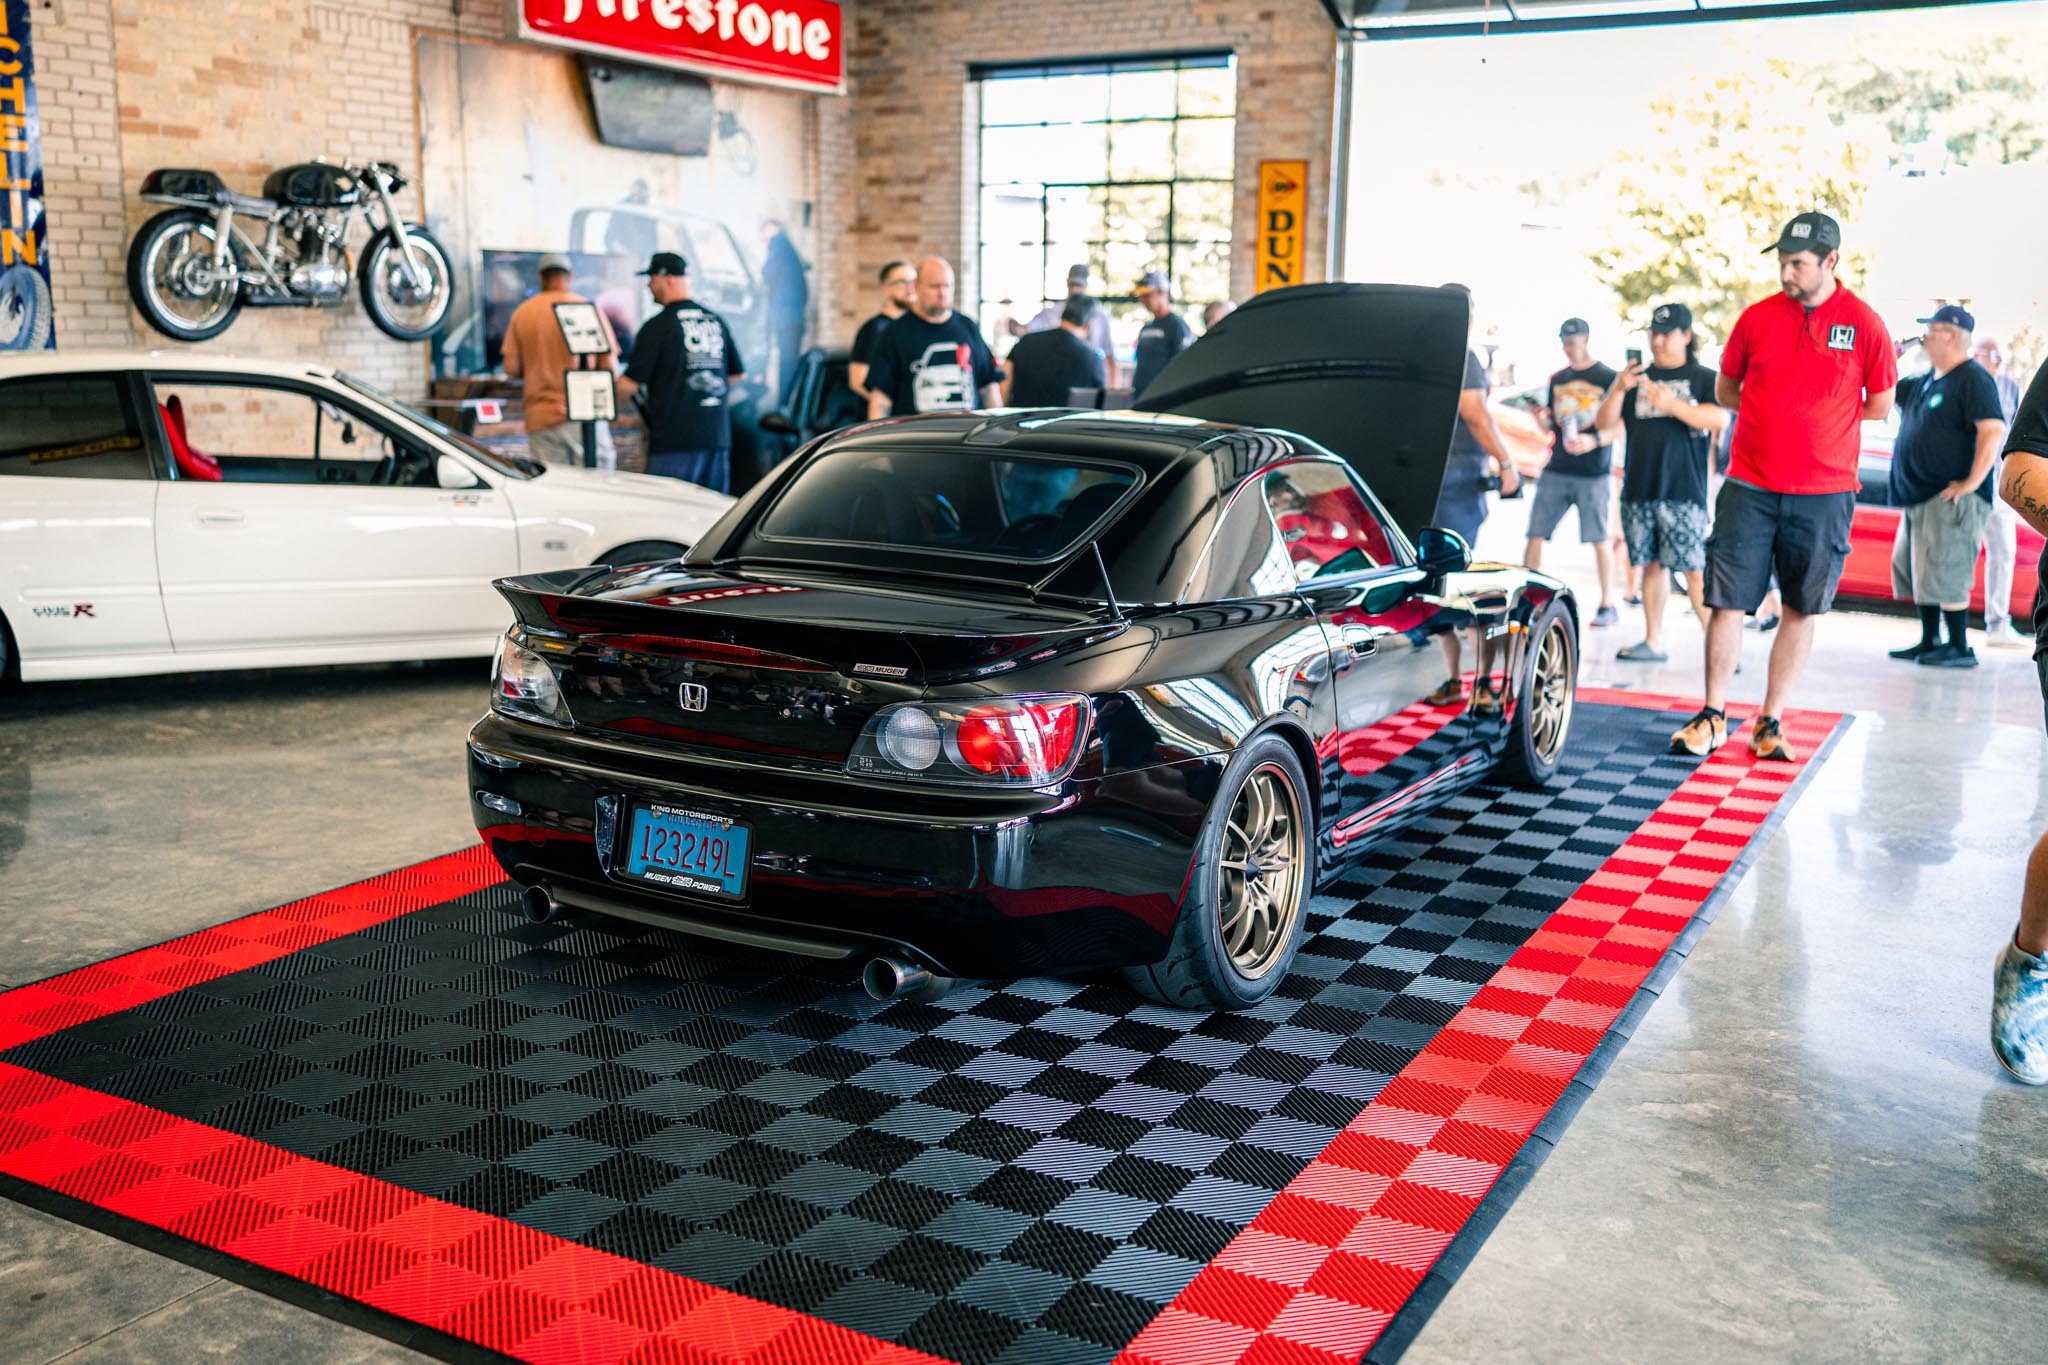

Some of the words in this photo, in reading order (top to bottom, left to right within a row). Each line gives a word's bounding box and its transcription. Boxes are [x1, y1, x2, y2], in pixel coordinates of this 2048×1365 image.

[875, 666, 905, 674] MUGEN
[651, 804, 671, 814] KING
[672, 808, 734, 825] MOTORSPORTS
[641, 824, 735, 878] 123249L
[644, 871, 672, 883] MUGEN
[692, 881, 720, 892] POWER
